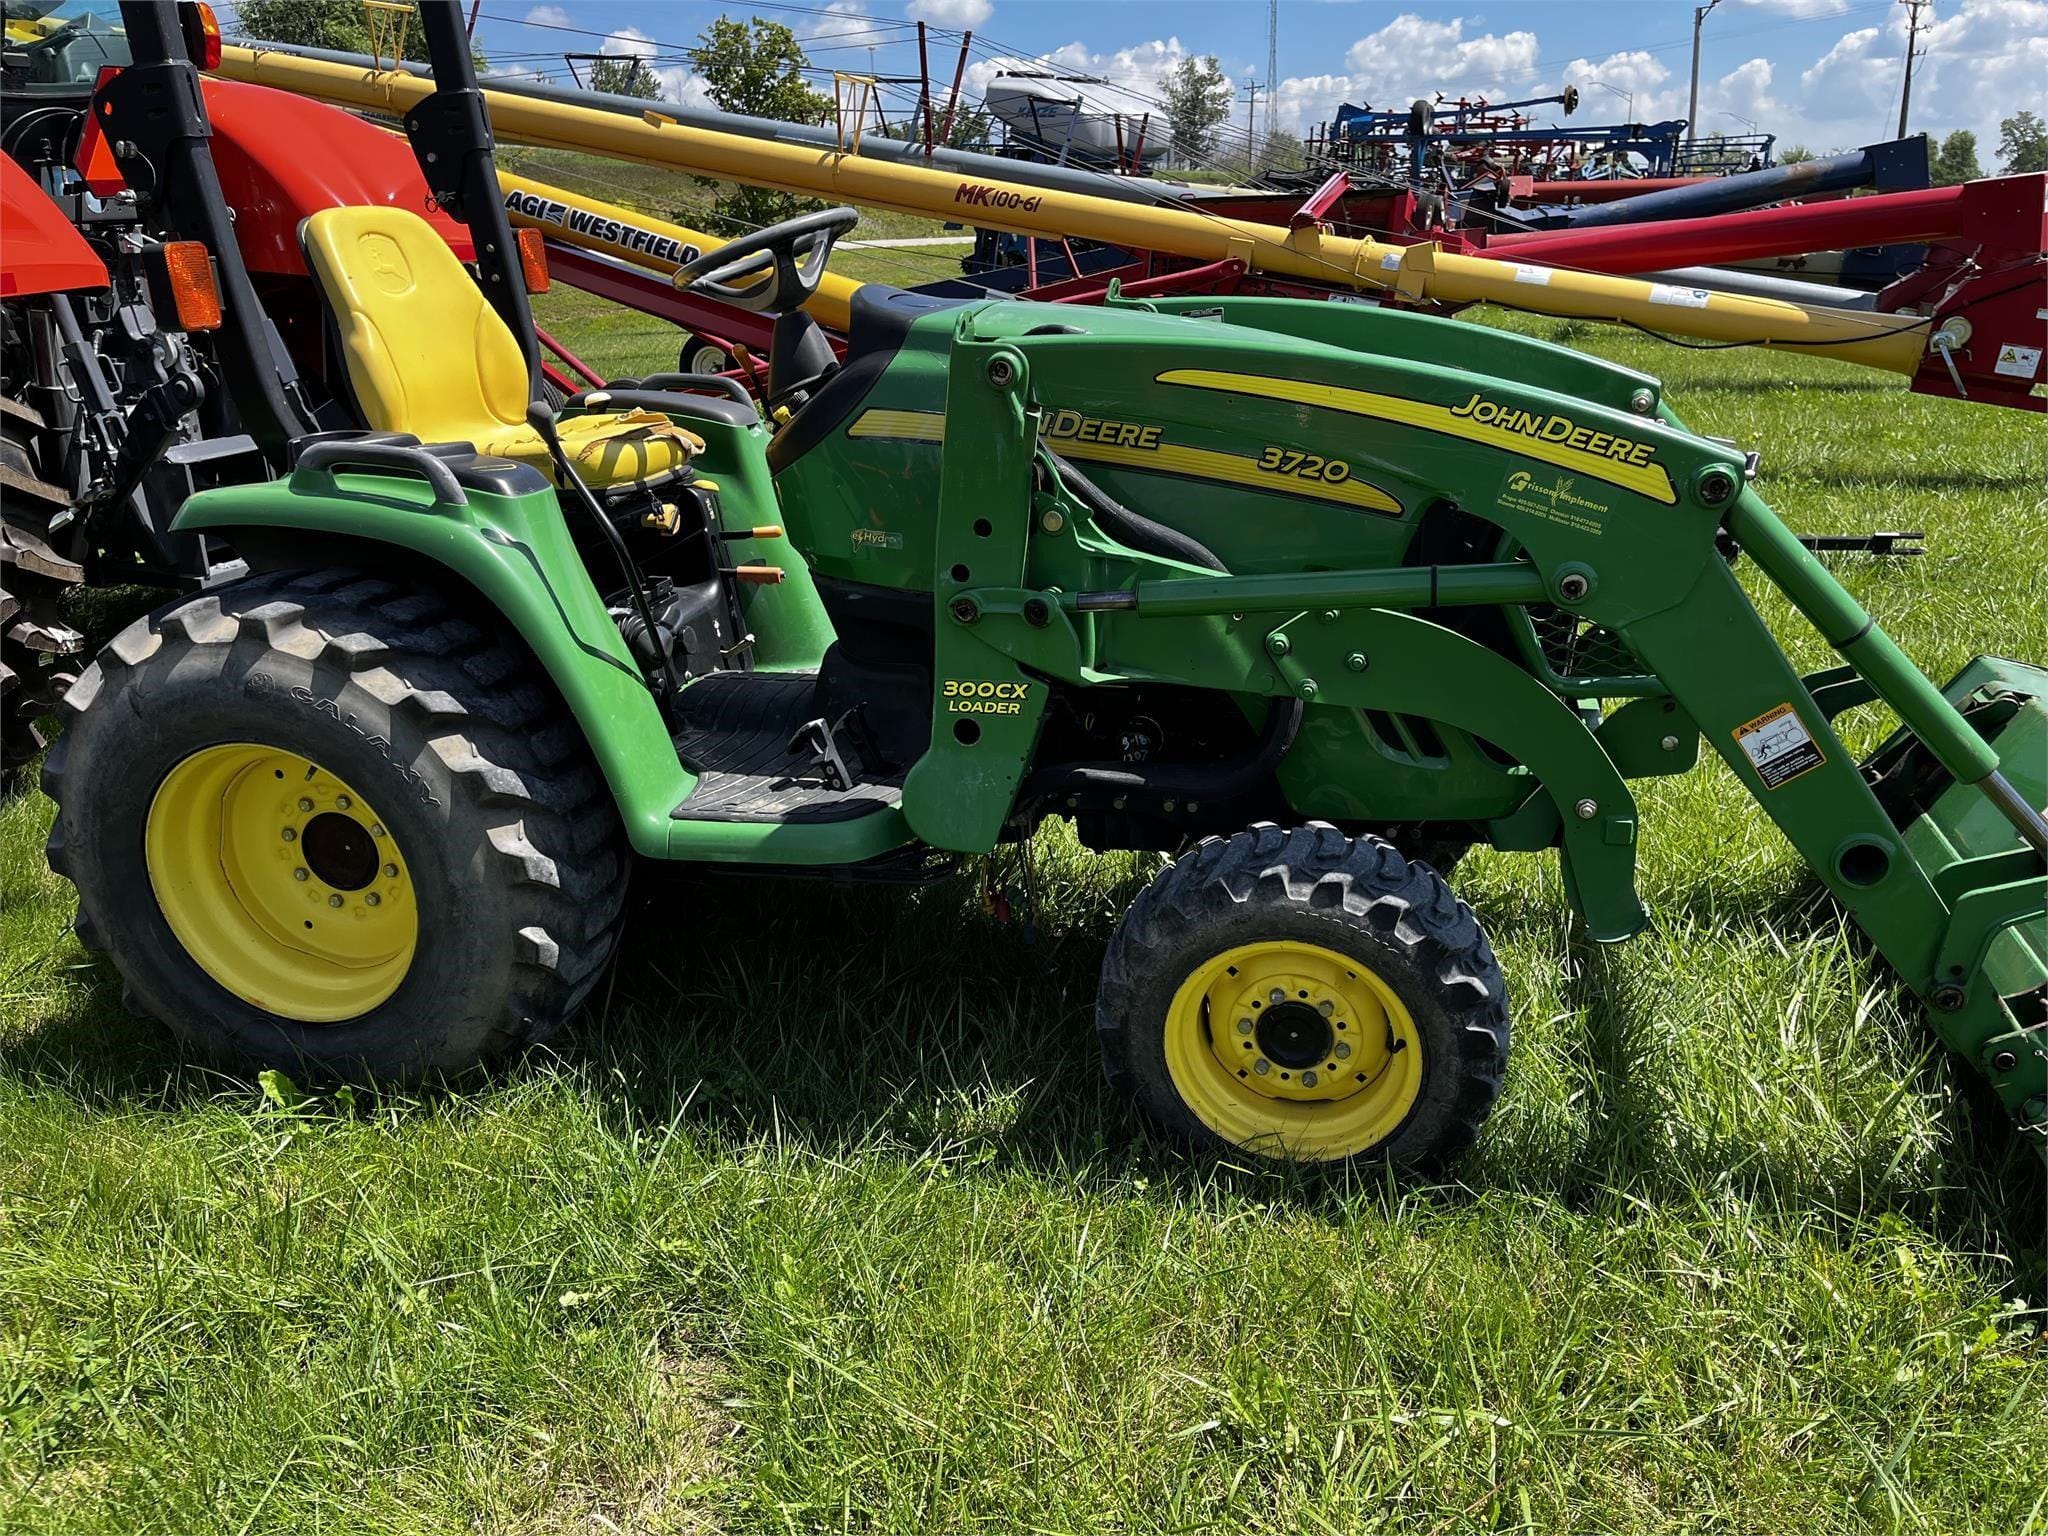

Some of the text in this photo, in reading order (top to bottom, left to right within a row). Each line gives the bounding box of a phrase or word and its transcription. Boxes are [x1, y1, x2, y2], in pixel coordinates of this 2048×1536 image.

[504, 189, 702, 266] AGI WESTFIELD
[1450, 393, 1656, 467] JOHN DEERE
[1257, 445, 1351, 484] 3720
[1508, 471, 1558, 498] Grissom
[1559, 491, 1609, 513] Implement
[942, 680, 1030, 700] 300CX
[948, 699, 1021, 715] LOADER
[1749, 706, 1787, 730] WARNING
[290, 685, 441, 807] GALAXY
